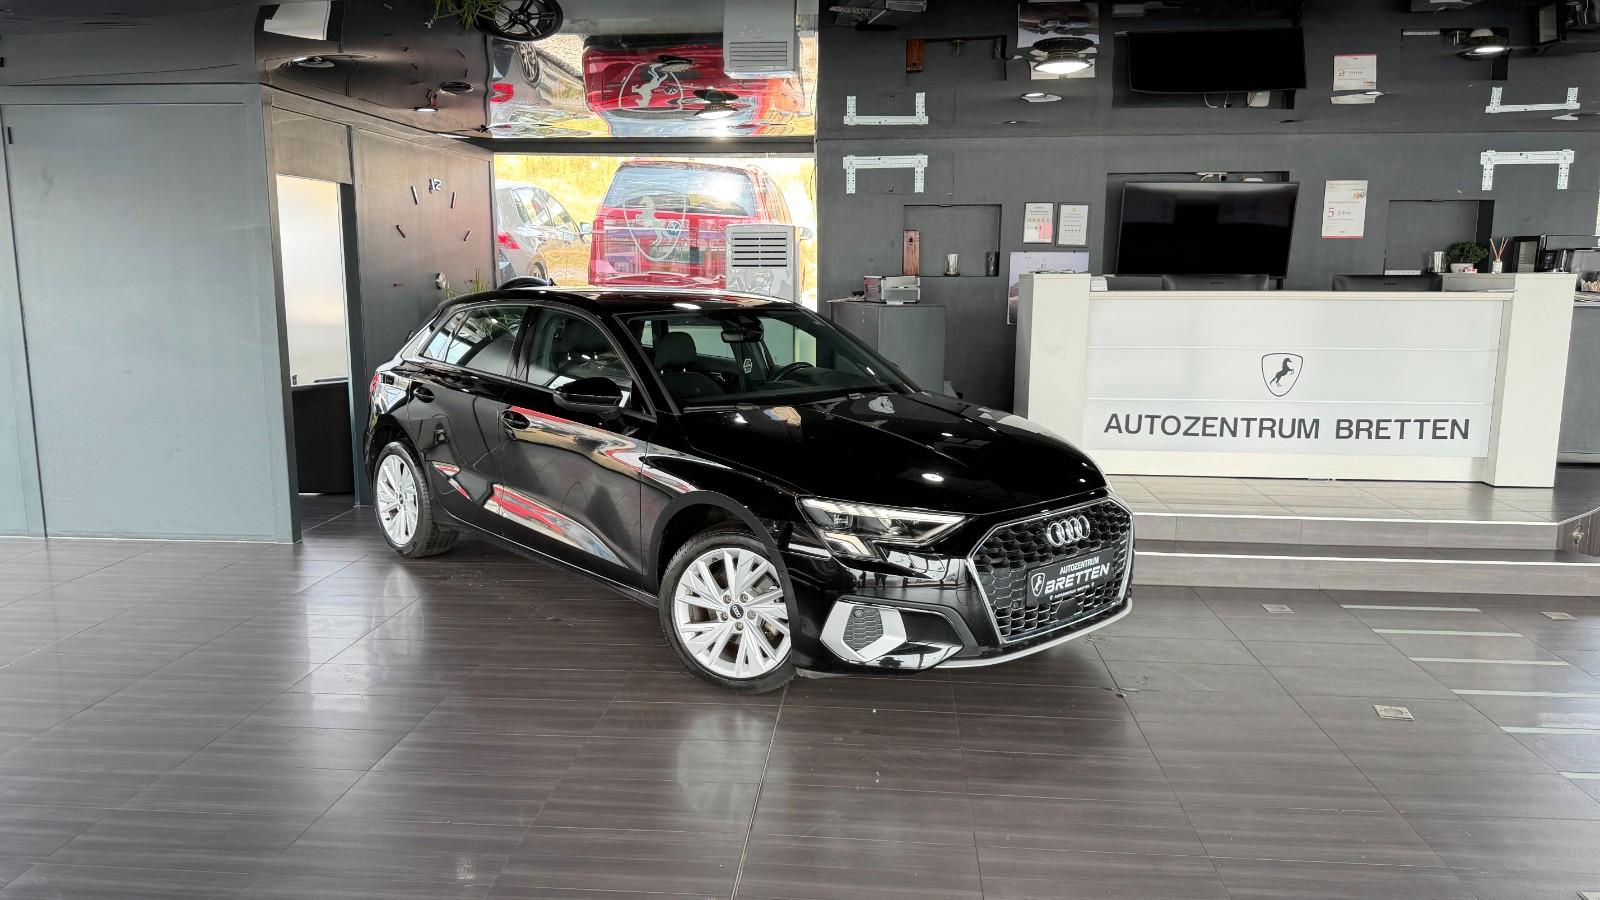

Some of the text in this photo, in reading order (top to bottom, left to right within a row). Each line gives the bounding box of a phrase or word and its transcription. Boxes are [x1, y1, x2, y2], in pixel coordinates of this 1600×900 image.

[1104, 413, 1470, 440] AUTOZENTRUM BRETTEN
[1045, 562, 1110, 594] BRETTEN
[1060, 556, 1100, 575] AUTOZENTRUM
